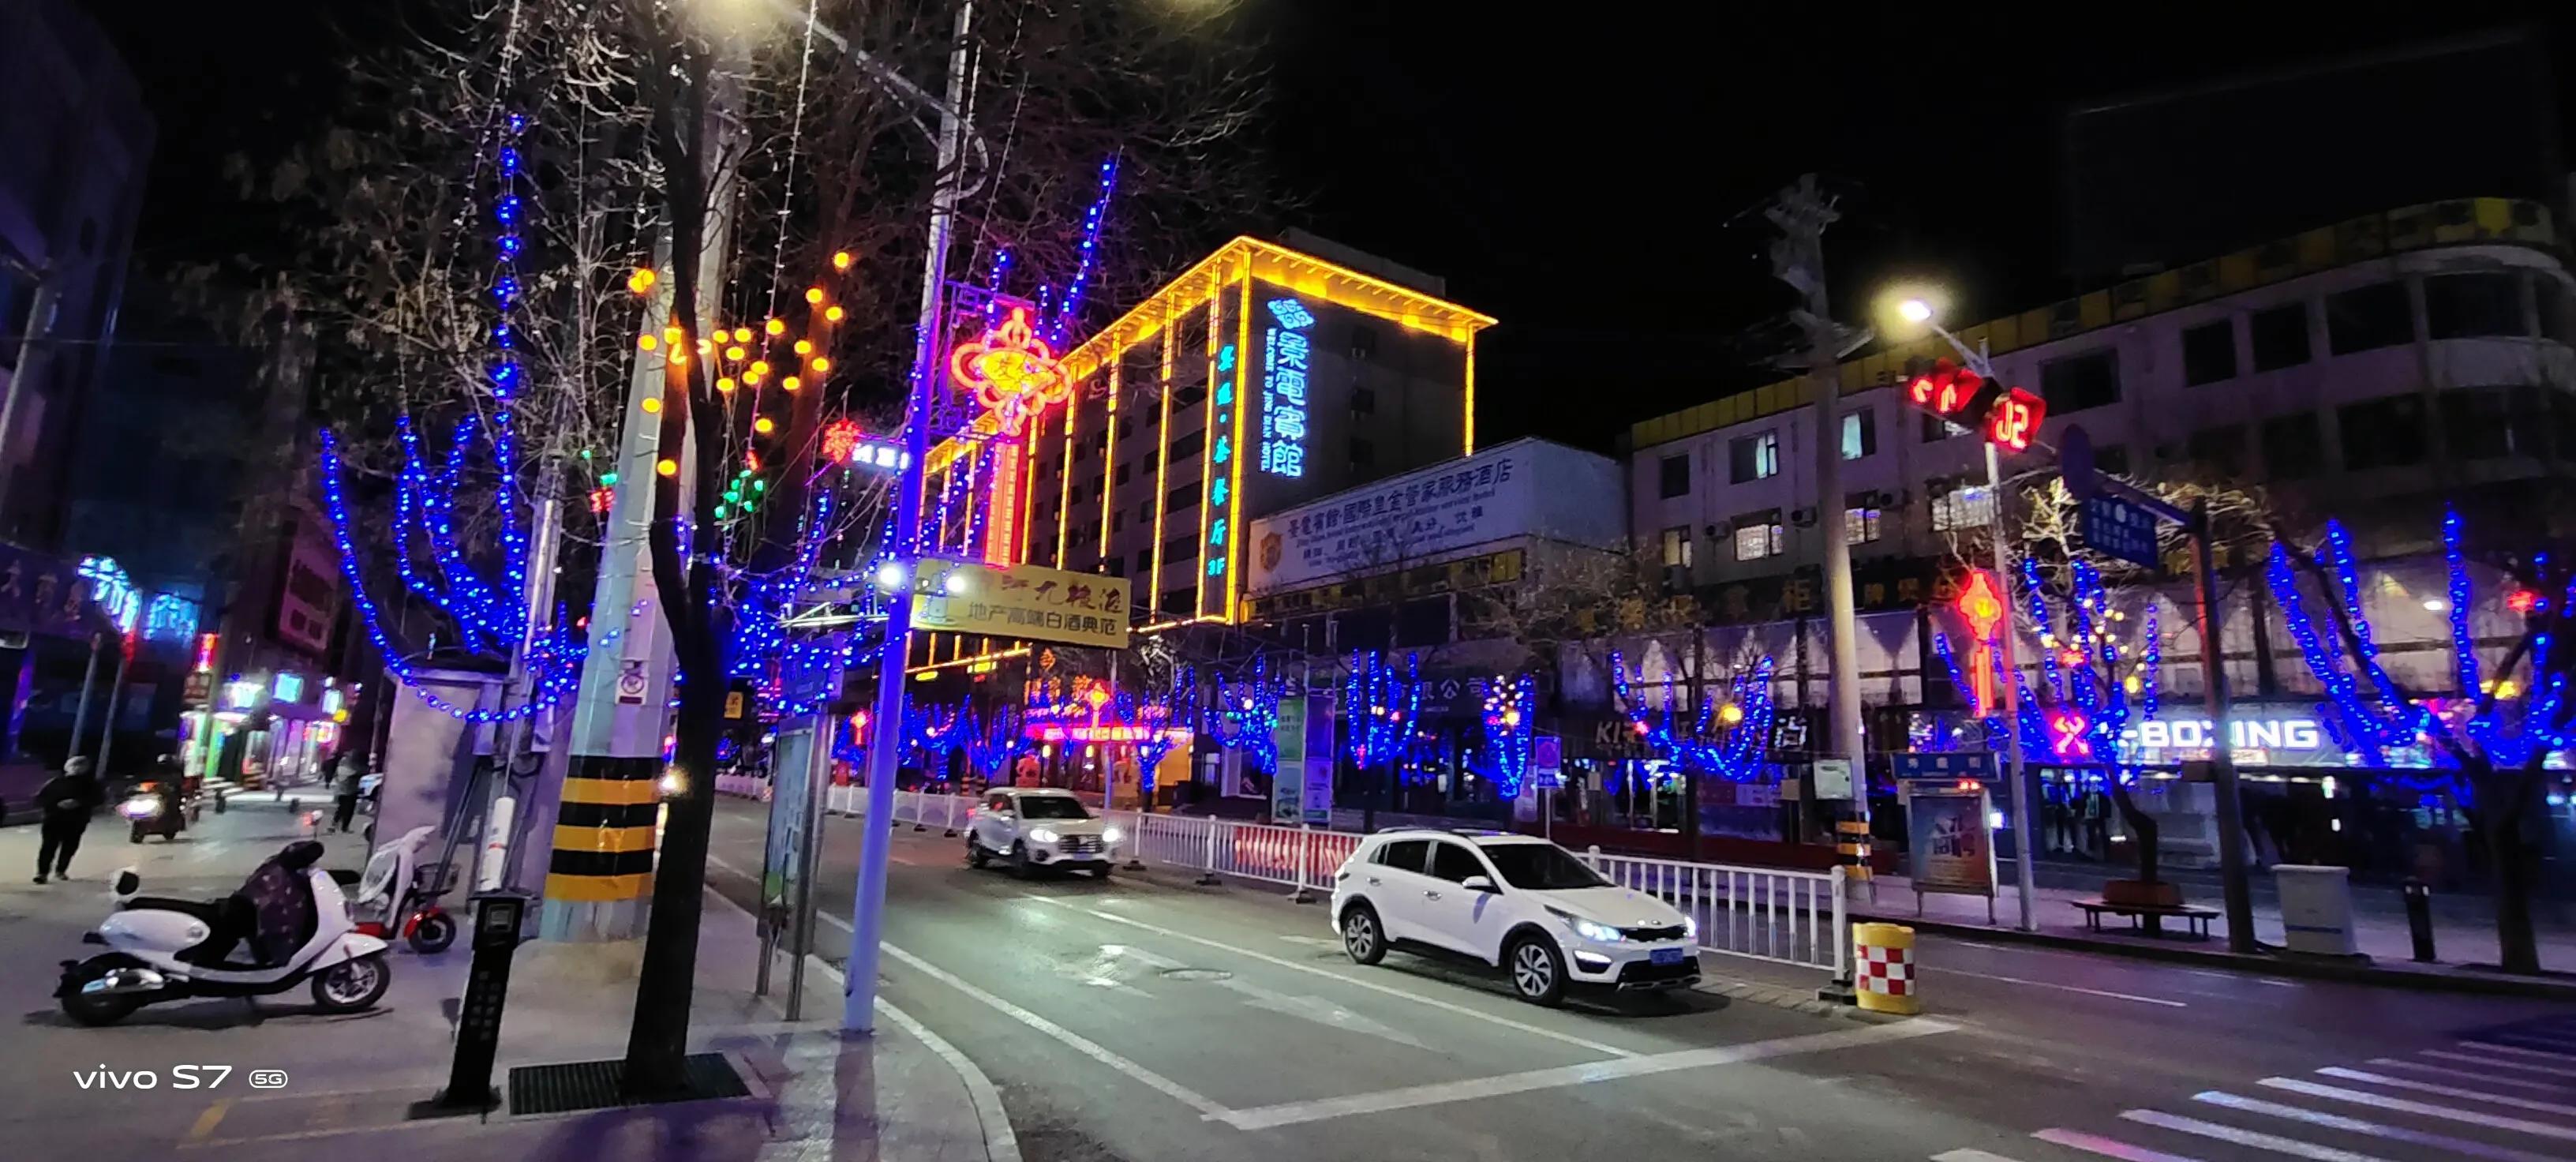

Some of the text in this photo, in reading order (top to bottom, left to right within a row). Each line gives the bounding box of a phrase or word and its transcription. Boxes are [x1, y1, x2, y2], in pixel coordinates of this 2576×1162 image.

[968, 601, 1118, 636] 地产高端白酒典范
